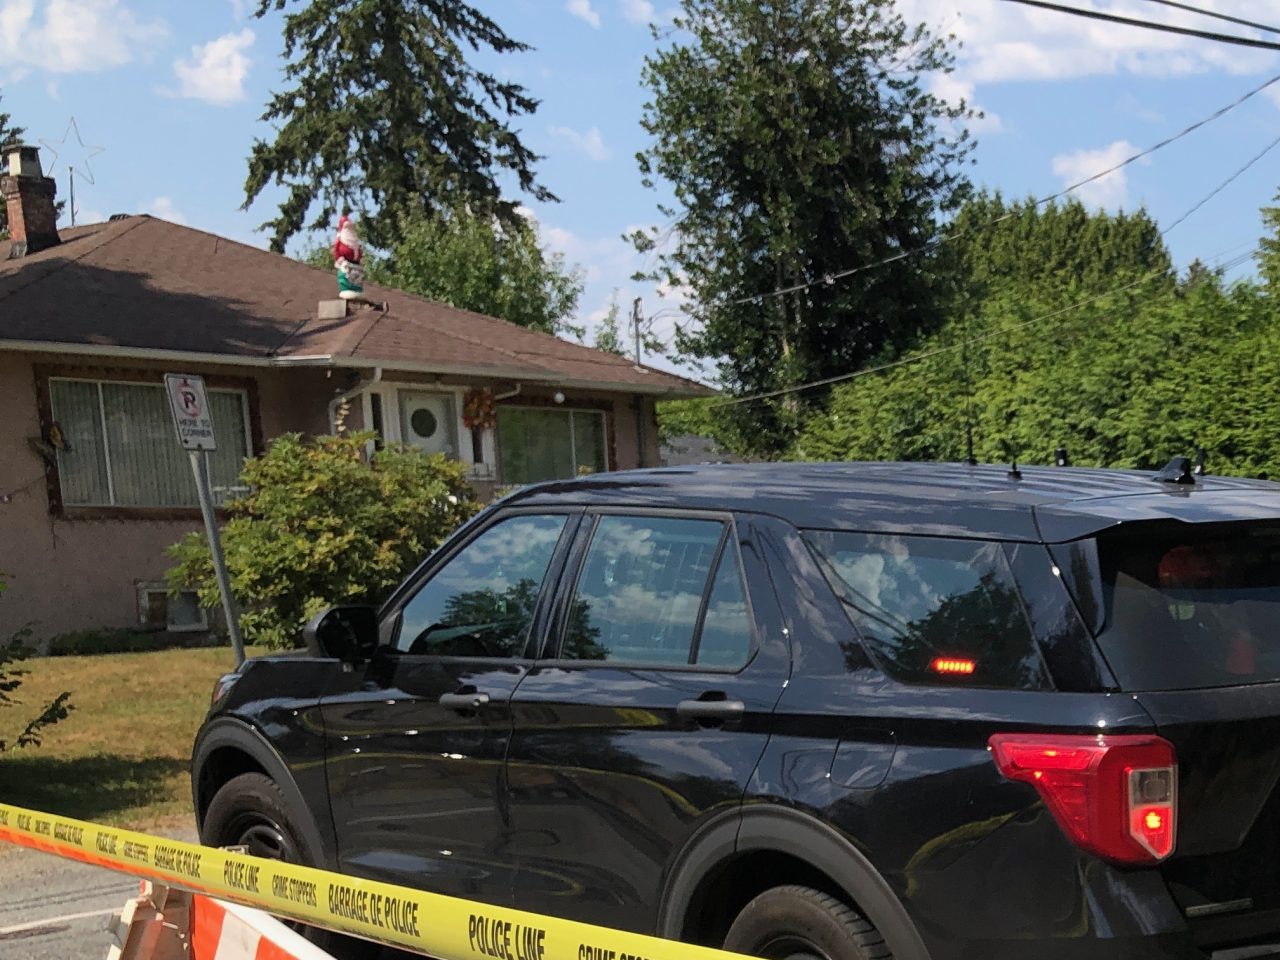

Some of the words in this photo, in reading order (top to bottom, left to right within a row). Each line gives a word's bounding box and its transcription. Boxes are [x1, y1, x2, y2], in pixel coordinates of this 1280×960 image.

[224, 860, 245, 889] POLICE
[245, 864, 260, 894] LINE
[272, 873, 288, 900] CRIME
[289, 877, 317, 908] STOPPERS
[328, 883, 370, 924] BARRAGE
[370, 892, 384, 928] DE
[384, 896, 421, 938] POLICE
